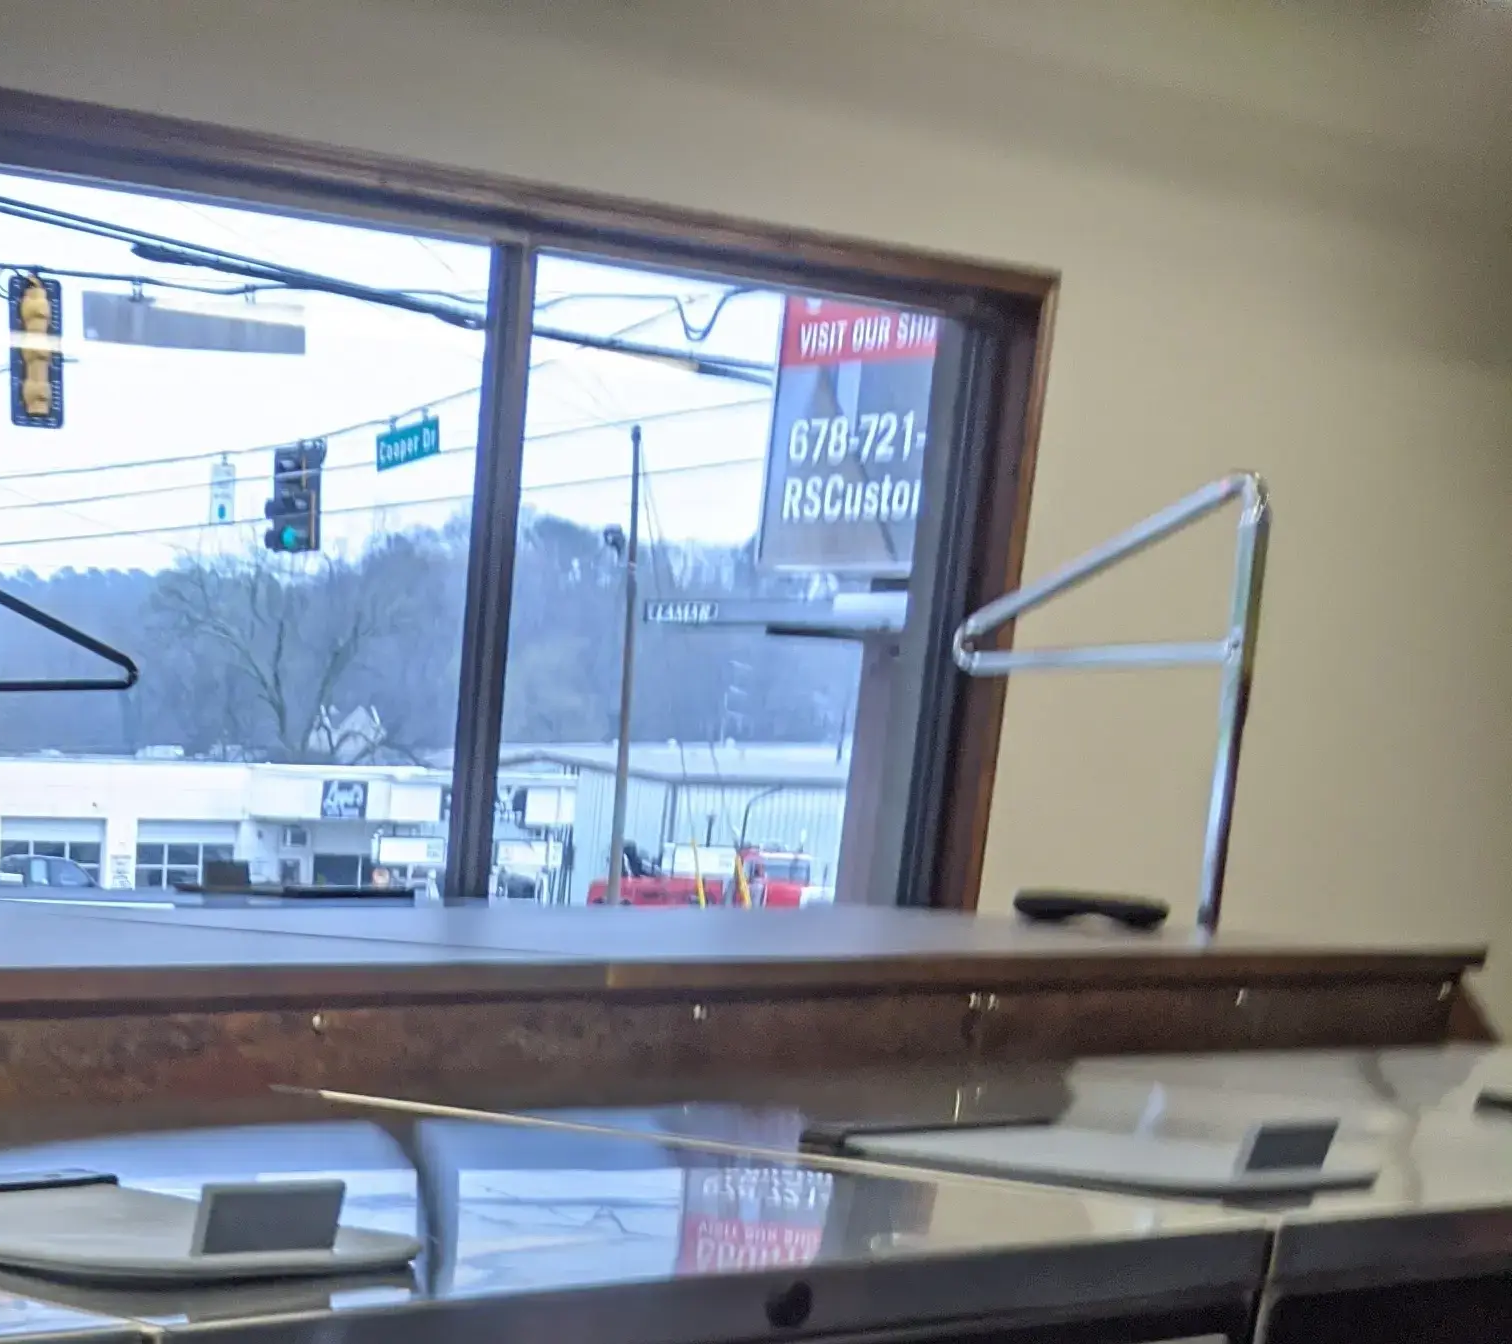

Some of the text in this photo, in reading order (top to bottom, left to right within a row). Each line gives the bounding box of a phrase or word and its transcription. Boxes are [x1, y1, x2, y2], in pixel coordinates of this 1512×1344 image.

[800, 319, 848, 358] VISIT
[852, 315, 892, 353] OUR
[379, 427, 436, 464] Cooper Dr
